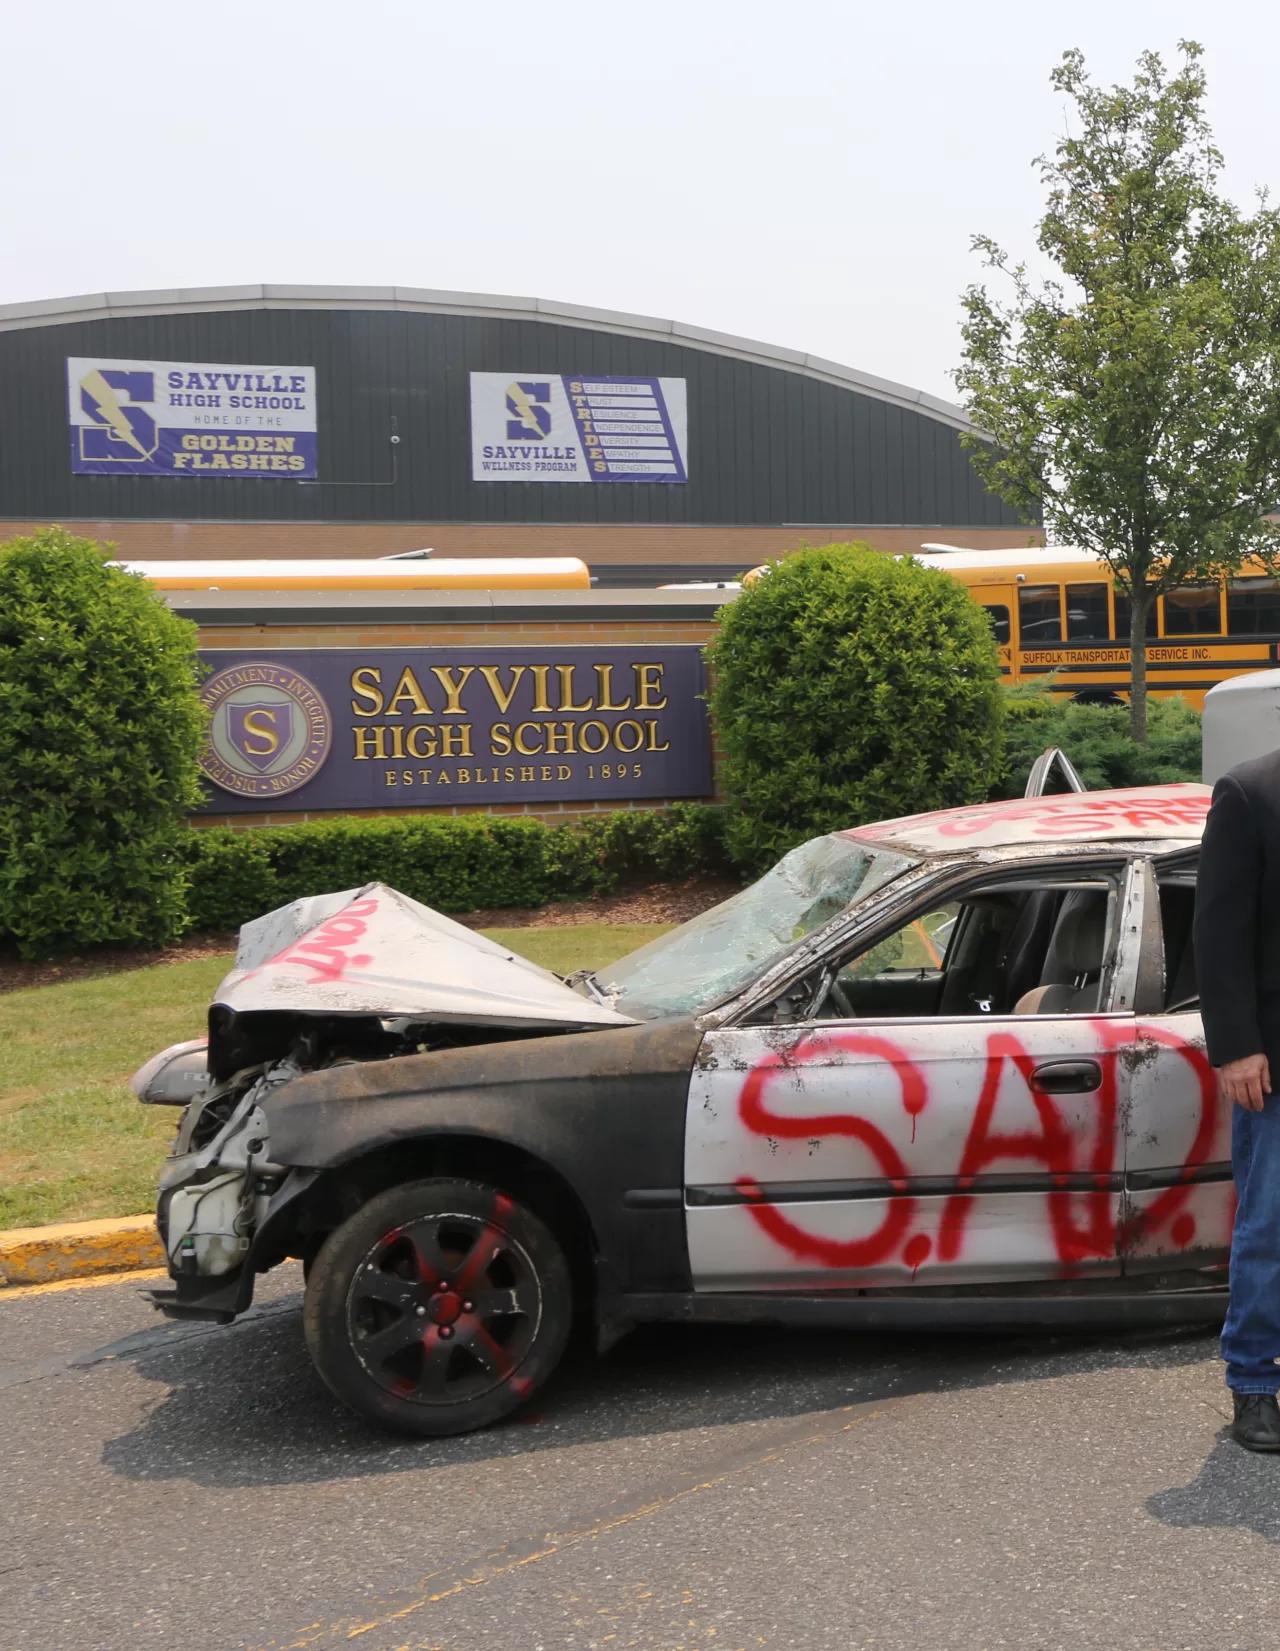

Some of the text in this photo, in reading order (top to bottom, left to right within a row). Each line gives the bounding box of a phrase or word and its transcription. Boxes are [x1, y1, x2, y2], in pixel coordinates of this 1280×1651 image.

[167, 371, 306, 393] SAYVILLE
[169, 393, 306, 410] HIGH SCHOOL
[194, 415, 283, 426] HOME OF THE
[181, 434, 296, 453] GOLDEN
[482, 446, 576, 459] SAYVILLE
[173, 452, 305, 471] FLASHES
[482, 461, 577, 472] WELLNESS PROGRAM
[1023, 648, 1212, 663] SUFFOLK TRANSPORTAT SERVICE INC.
[202, 669, 279, 708] MMITMENT
[350, 662, 668, 717] SAYVILLE
[286, 678, 327, 747] INTEGRITY
[243, 709, 280, 756] S
[352, 719, 670, 760] HIGH SCHOOL
[202, 755, 257, 793] DISCIPLI
[269, 757, 317, 791] HONOR
[385, 763, 643, 787] ESTABLISHED 1895
